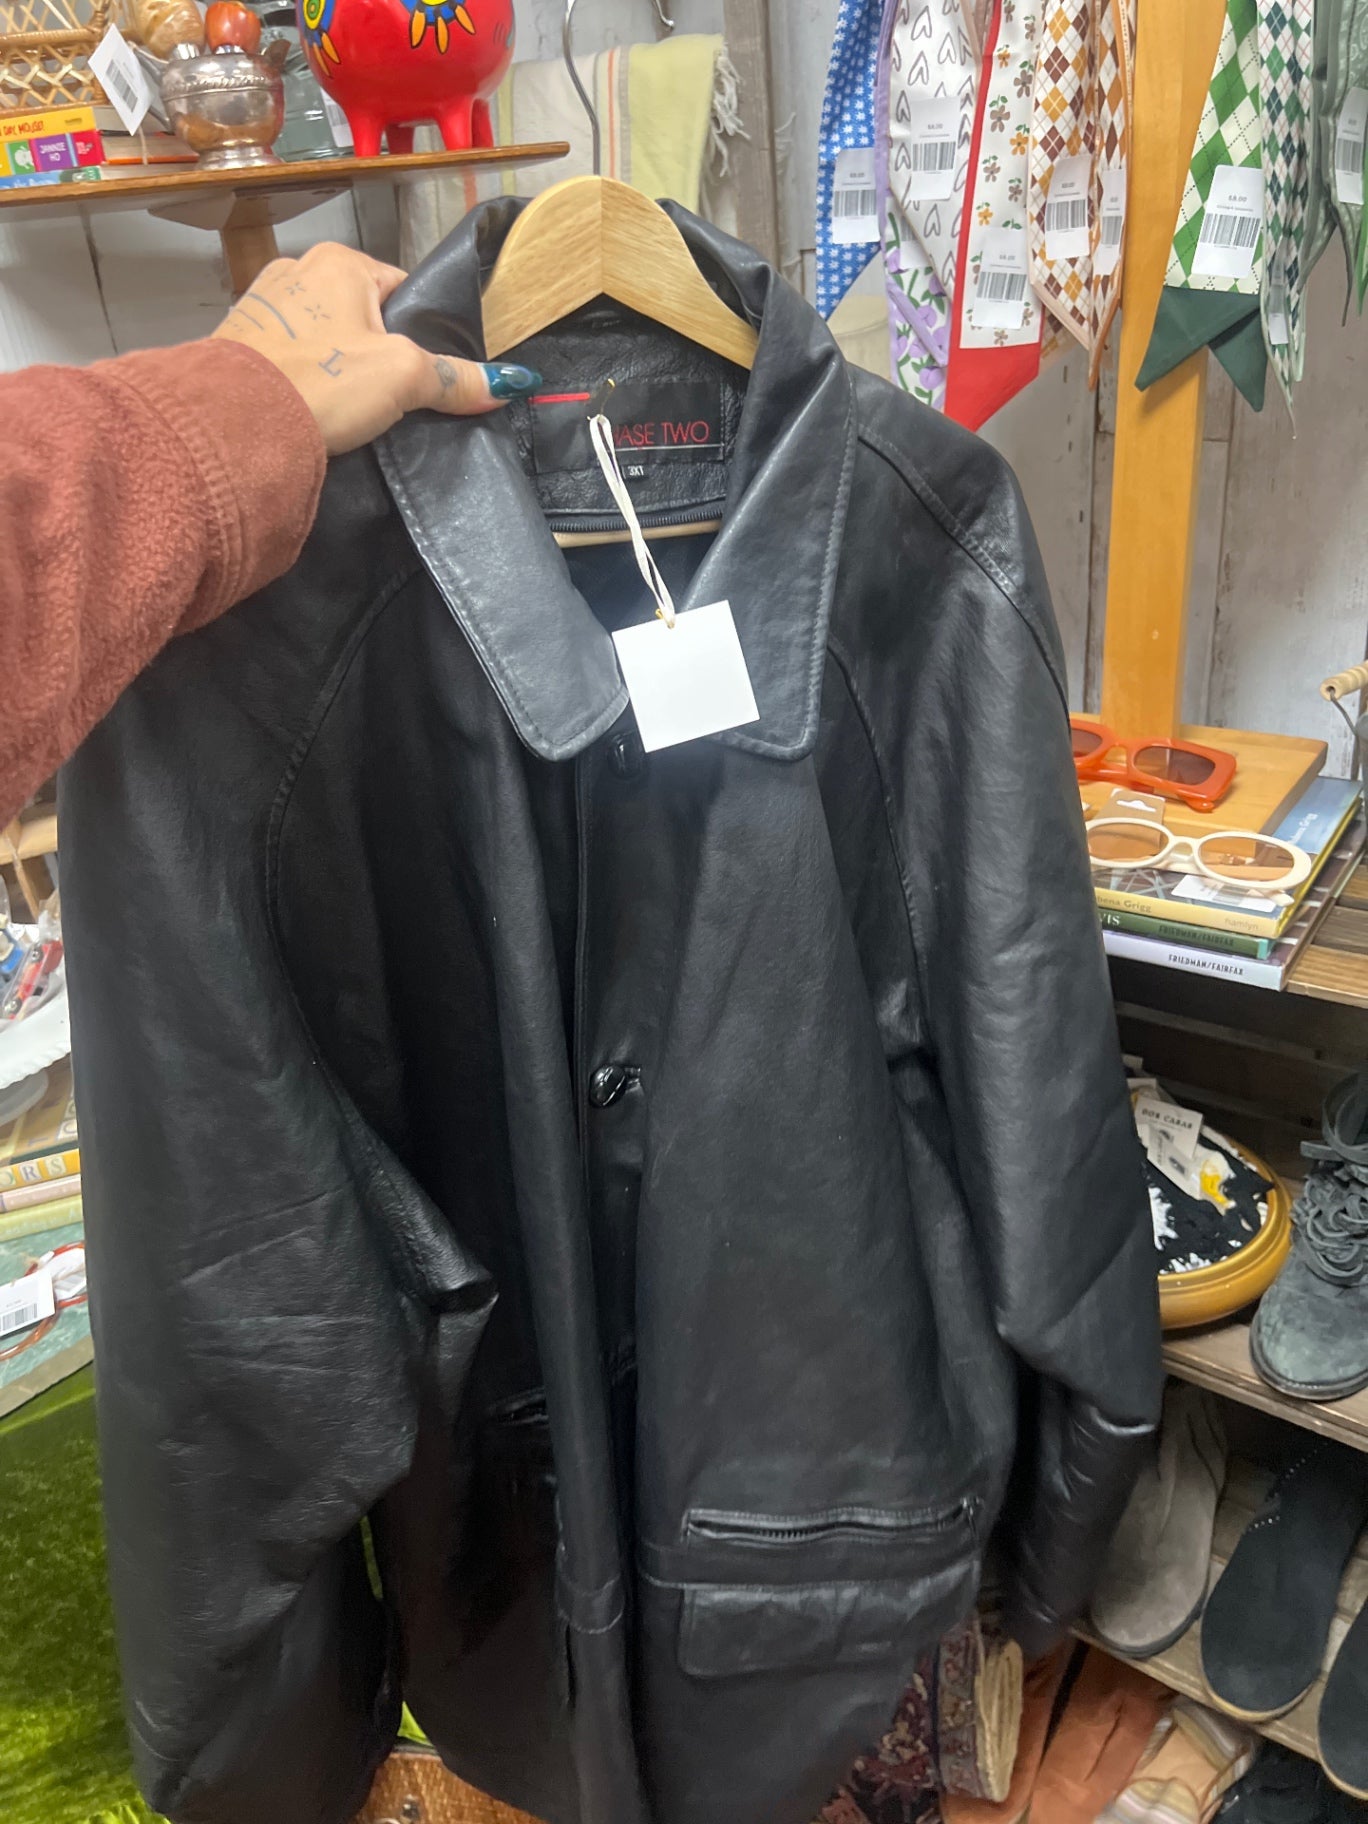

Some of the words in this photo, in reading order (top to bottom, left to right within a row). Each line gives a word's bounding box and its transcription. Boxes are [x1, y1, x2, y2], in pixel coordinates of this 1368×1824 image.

[49, 152, 61, 162] HO
[660, 420, 710, 445] TWO
[1123, 899, 1153, 914] Grigg
[1167, 953, 1245, 976] FRIEDMAN/FAIRFAX
